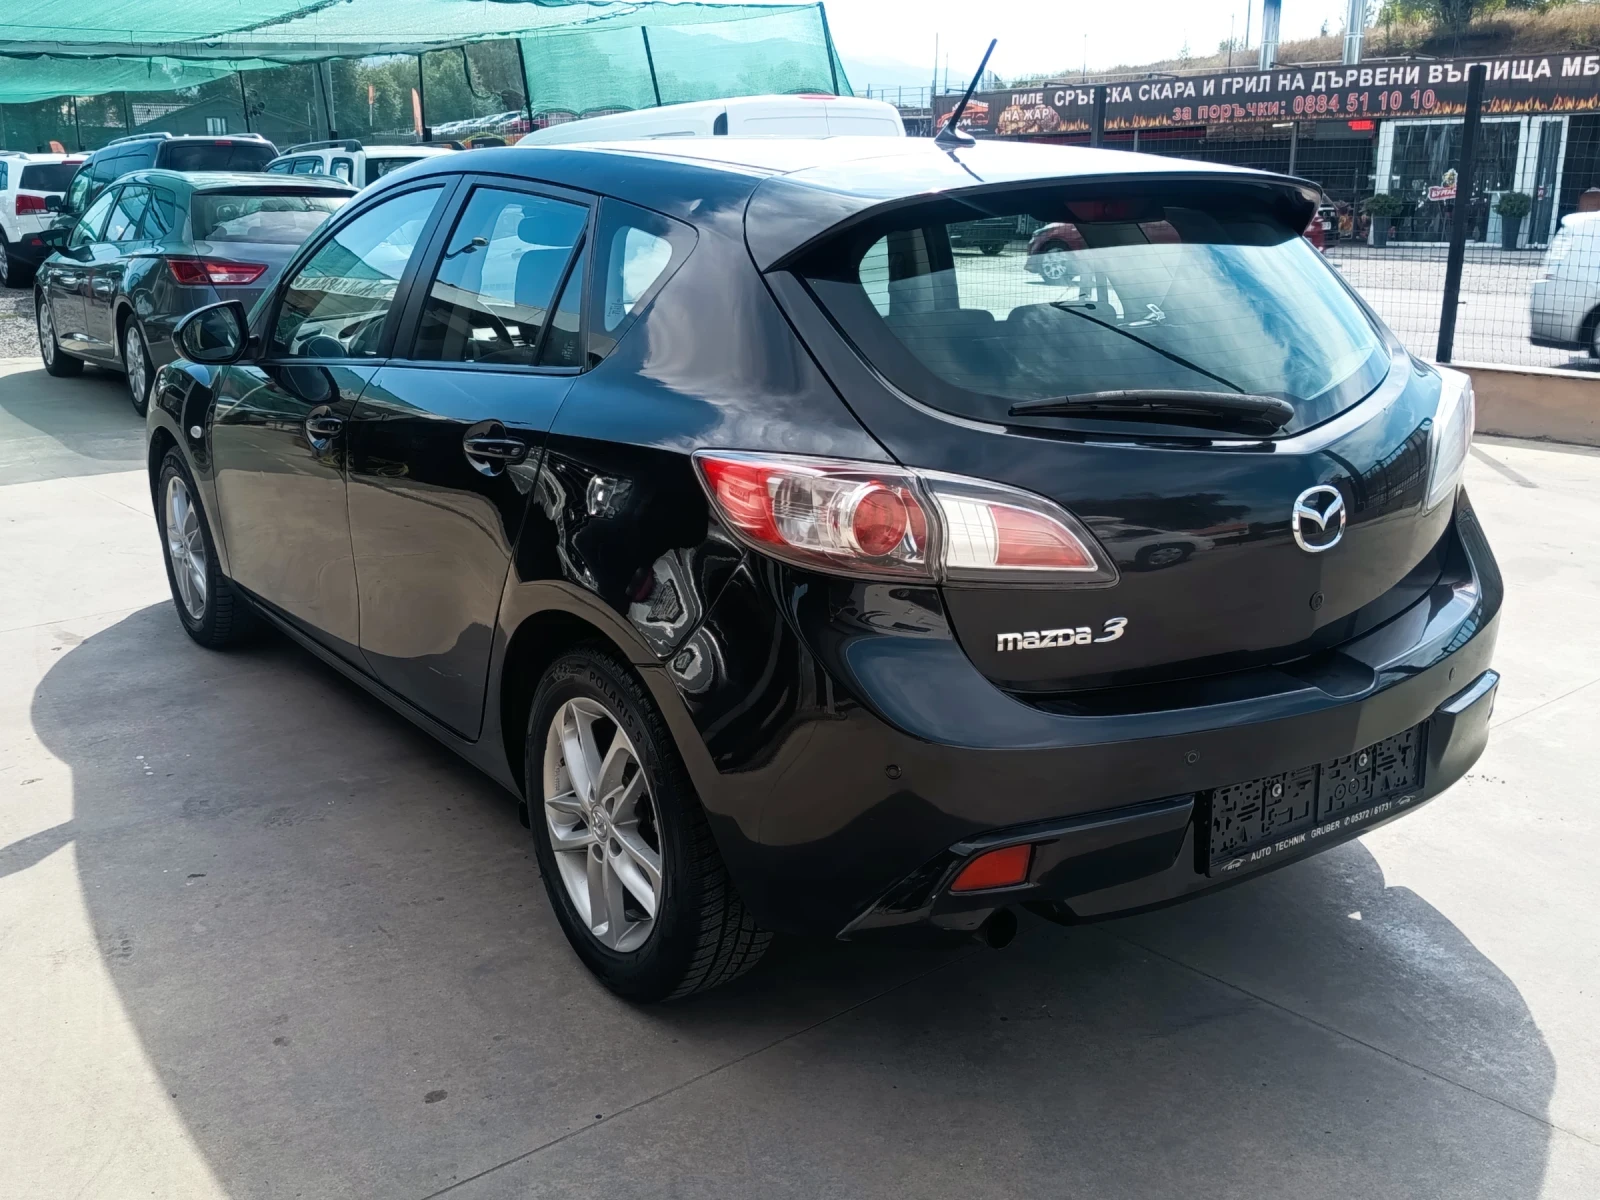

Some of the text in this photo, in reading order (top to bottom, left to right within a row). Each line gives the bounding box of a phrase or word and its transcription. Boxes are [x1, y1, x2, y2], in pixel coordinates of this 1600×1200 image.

[1011, 92, 1044, 105] ПИЛЕ
[1138, 81, 1196, 101] СКАРА
[1202, 79, 1215, 96] И
[1221, 74, 1271, 95] ГРИЛ
[1278, 72, 1305, 91] НА
[1311, 66, 1420, 92] ДЪРВЕНИ
[1004, 108, 1050, 121] НА ЖАР
[1172, 89, 1435, 122] за поръчки: 0884 51 10 10
[1093, 616, 1128, 643] 3
[589, 671, 643, 743] POLARIS 5
[1250, 846, 1272, 862] AUTO
[1274, 833, 1306, 852] TECHNIK
[1310, 820, 1341, 838] GRUBER
